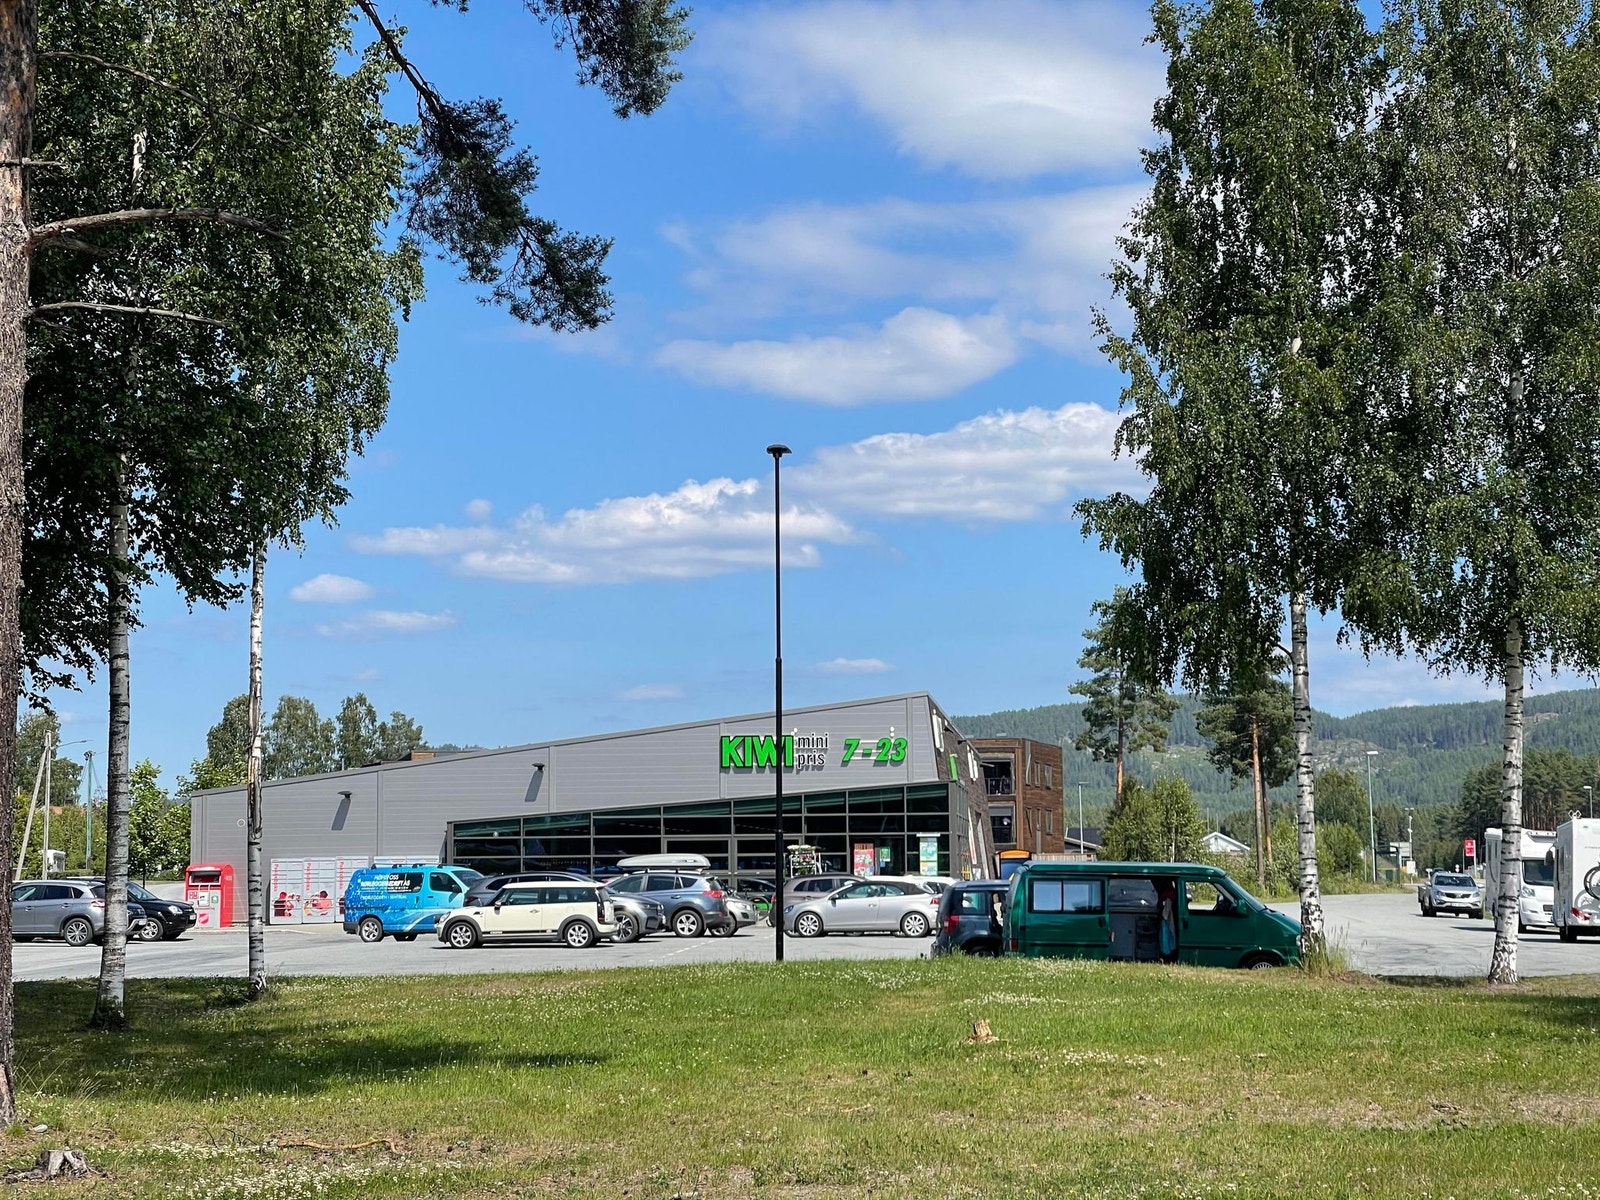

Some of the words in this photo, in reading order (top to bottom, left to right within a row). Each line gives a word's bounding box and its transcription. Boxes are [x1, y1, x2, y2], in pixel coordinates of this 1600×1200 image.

[798, 733, 828, 748] mini
[721, 735, 794, 767] KIWI
[798, 751, 825, 767] pris
